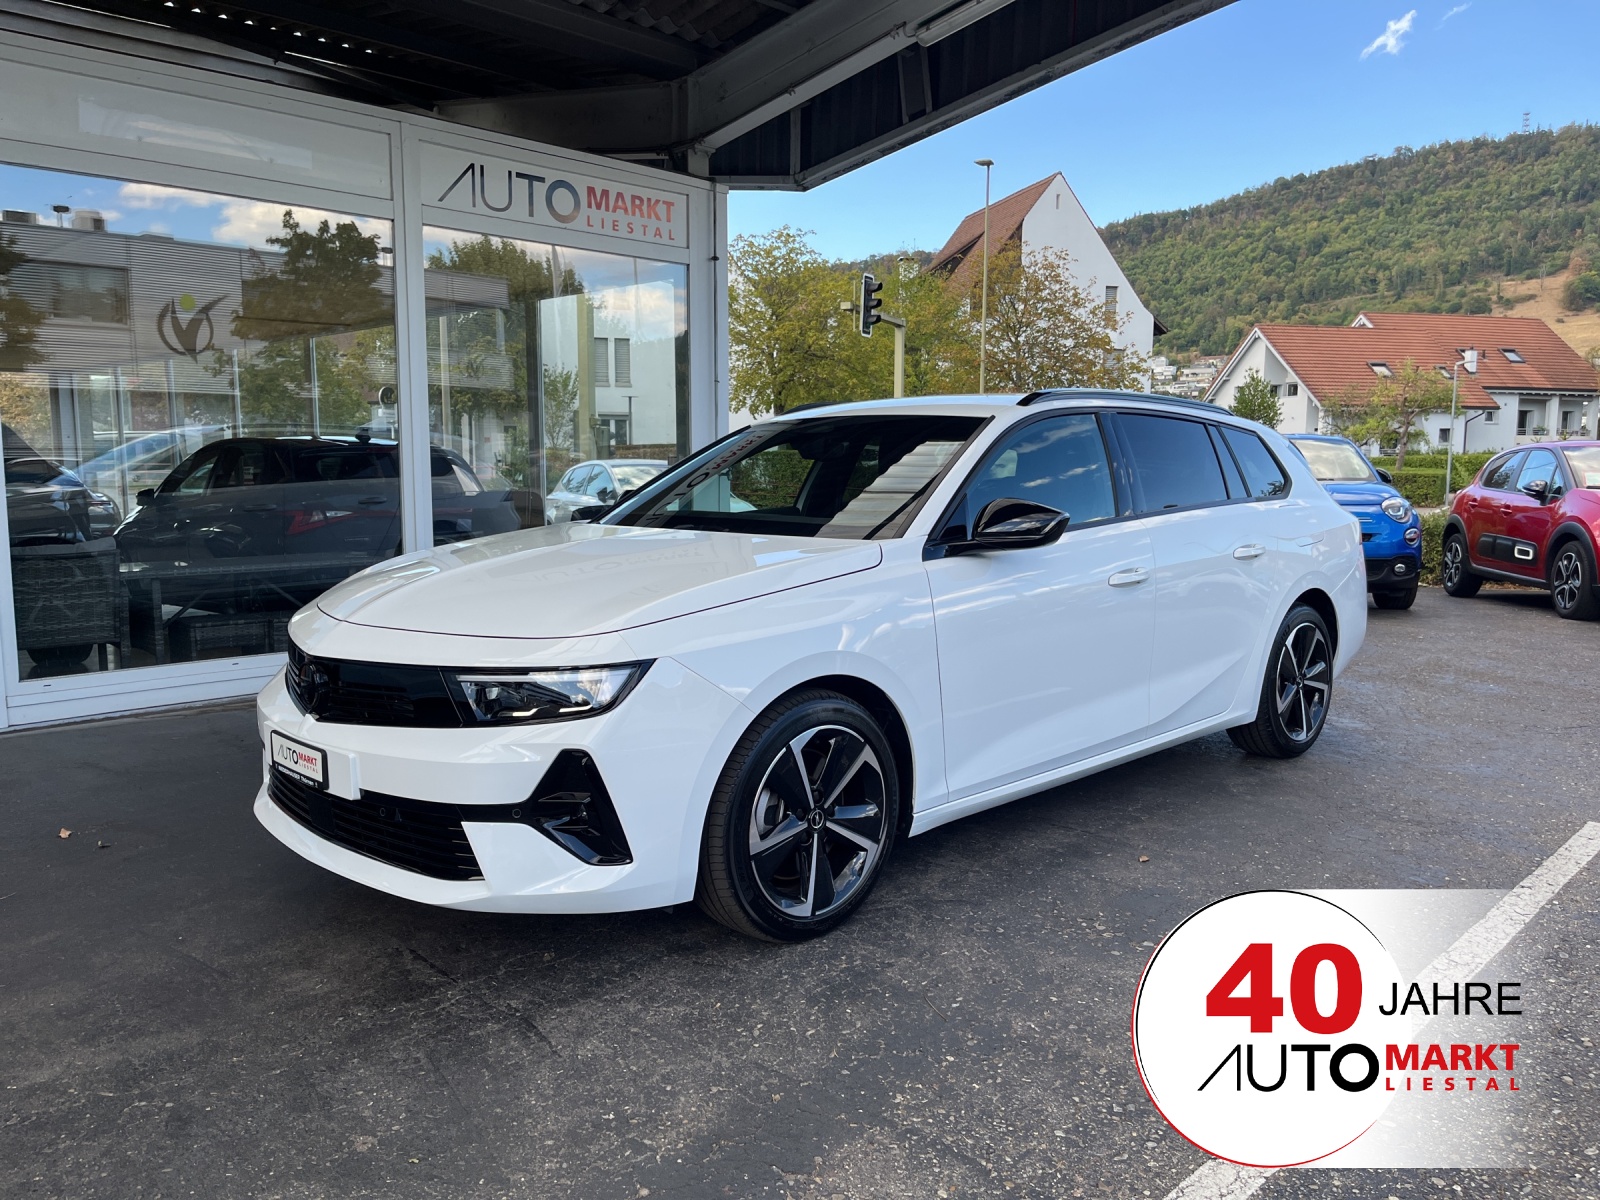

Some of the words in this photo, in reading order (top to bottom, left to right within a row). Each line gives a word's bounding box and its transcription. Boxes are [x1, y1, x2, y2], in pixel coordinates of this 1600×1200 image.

[586, 185, 675, 223] MARKT
[586, 215, 675, 241] LIESTAL
[298, 762, 319, 774] LIESTAL
